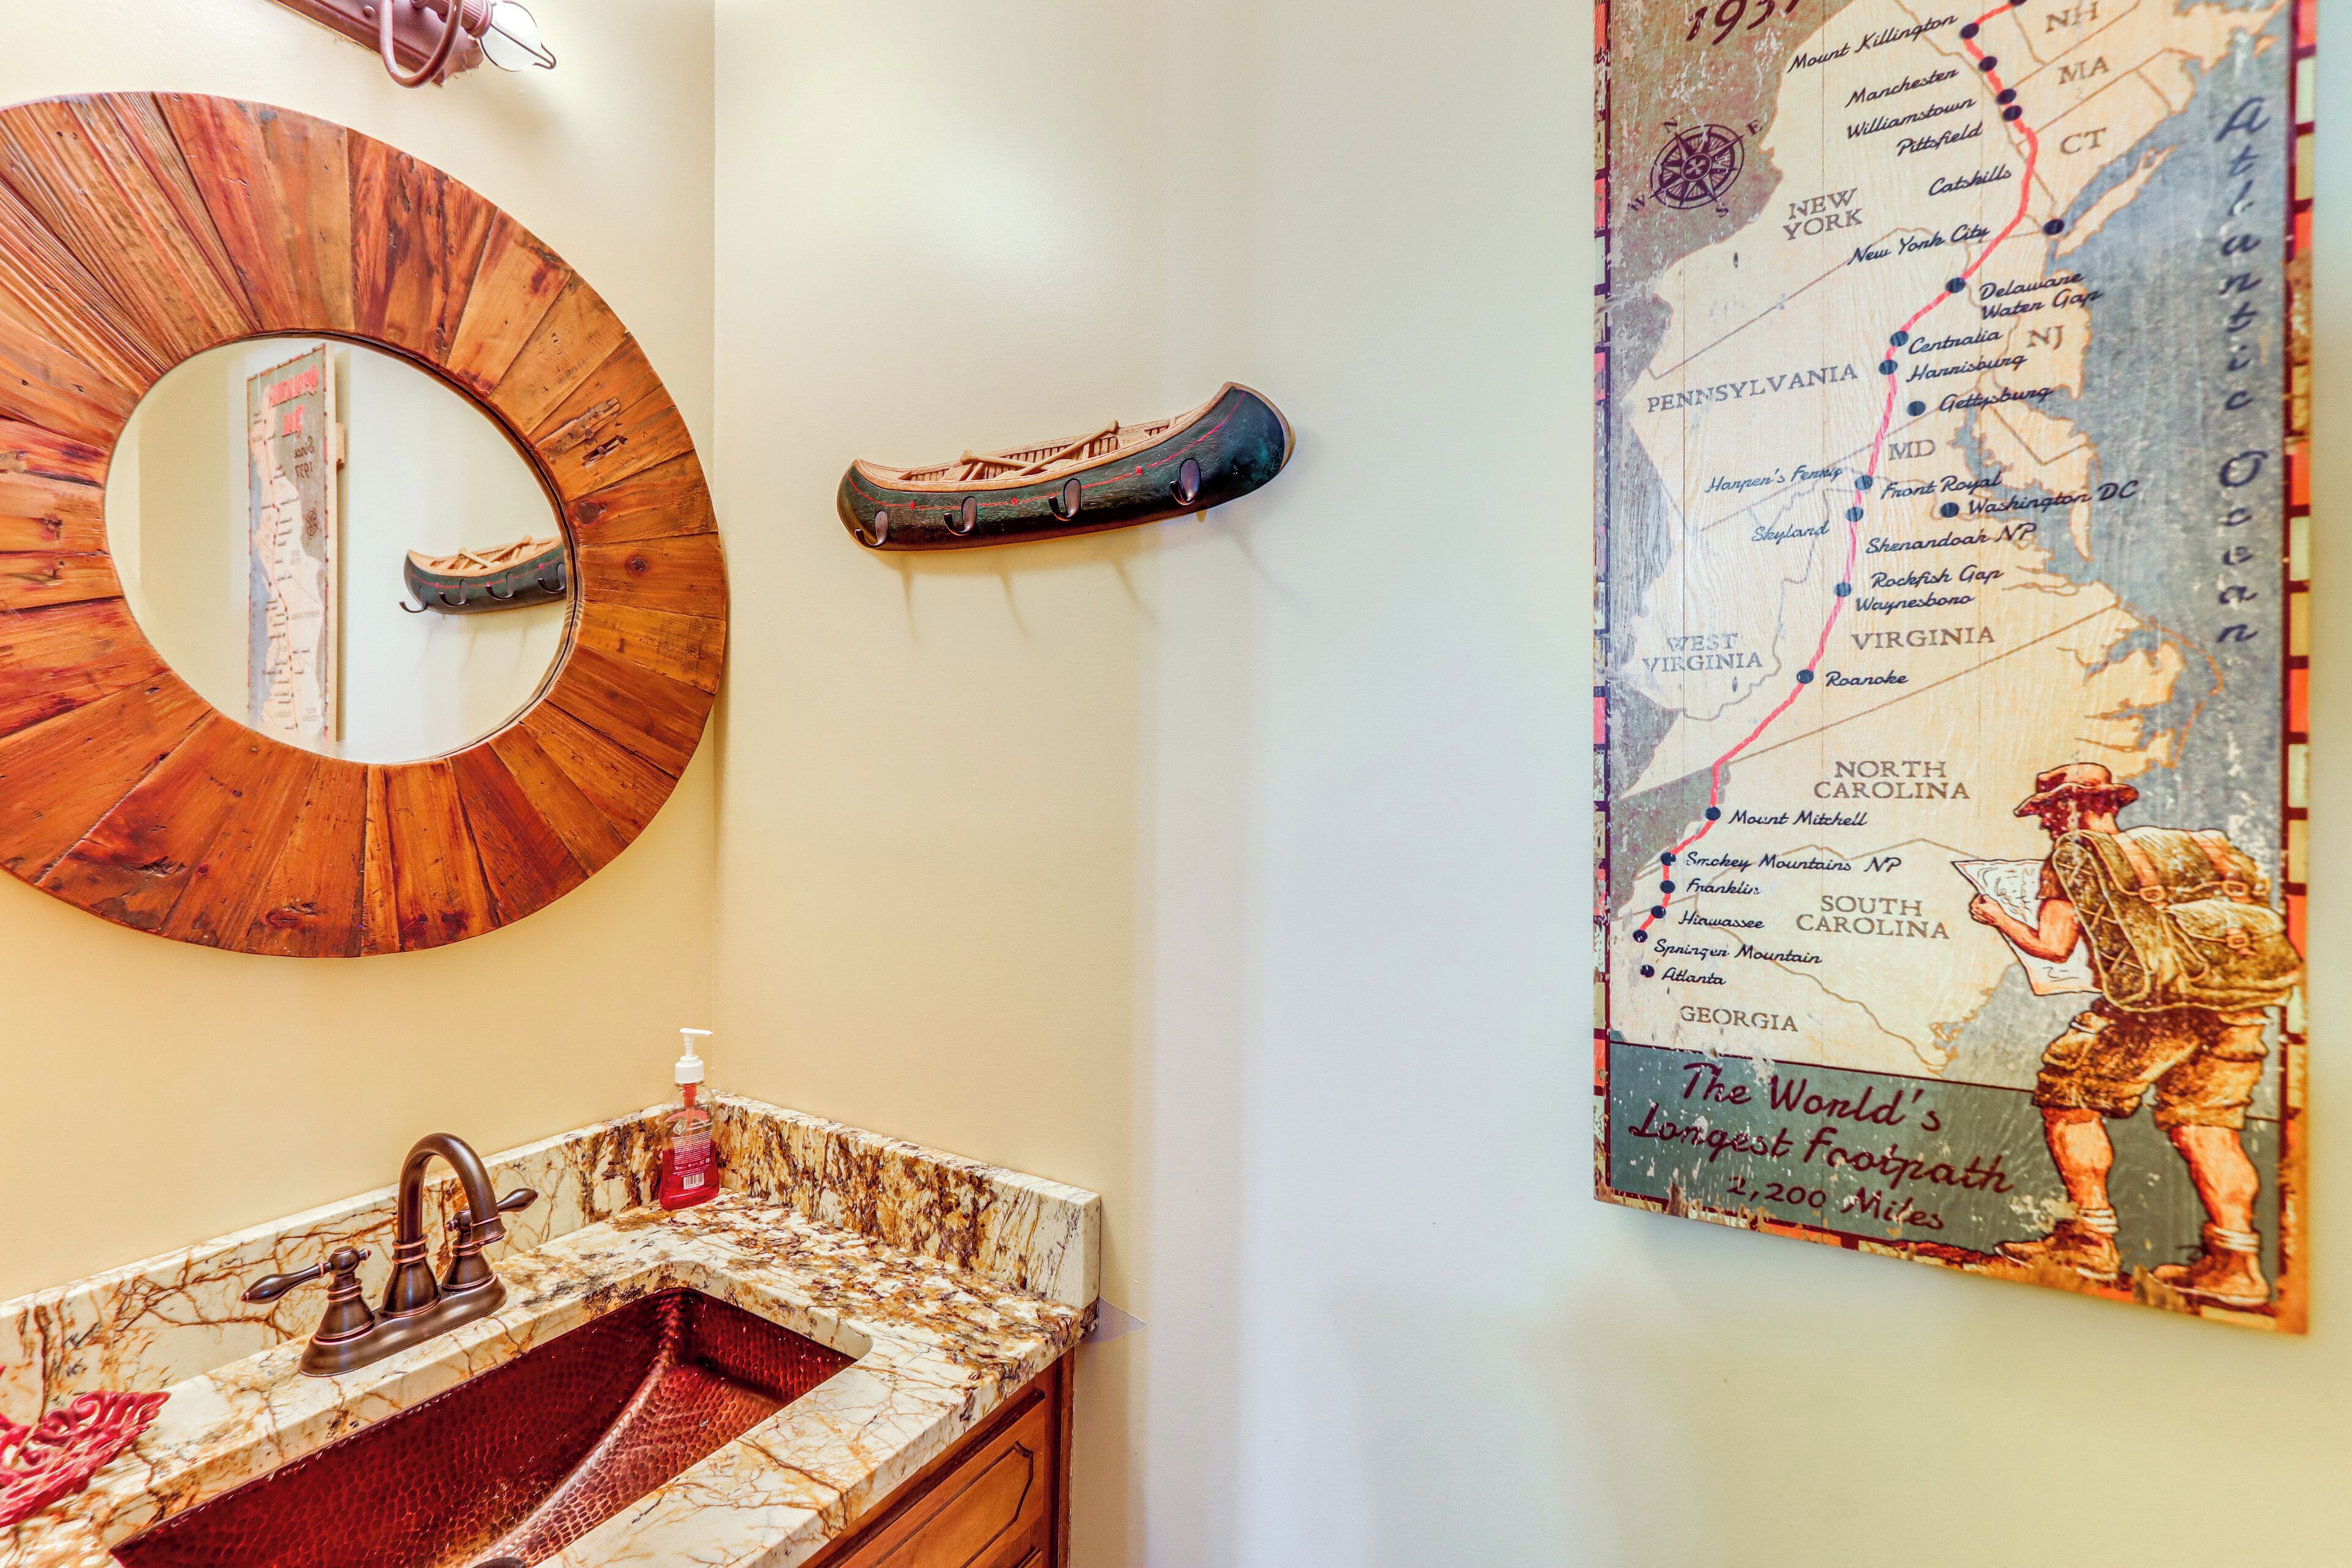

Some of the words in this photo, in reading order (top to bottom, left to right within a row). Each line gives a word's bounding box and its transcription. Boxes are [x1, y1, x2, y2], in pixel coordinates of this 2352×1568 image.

[1686, 0, 1798, 46] 193
[2045, 2, 2100, 33] NH
[1787, 43, 1851, 74] Mount
[1854, 15, 1959, 54] Killington
[2058, 56, 2109, 85] MA
[1845, 69, 1959, 108] Manchester
[1847, 98, 1977, 139] Williamstown
[1896, 121, 1983, 156] Pittsfield
[2060, 128, 2107, 155] CT
[1928, 164, 2012, 196] Catskills
[1789, 188, 1858, 221] NEW
[1783, 208, 1863, 241] YORK
[1847, 244, 1891, 265] New
[1898, 231, 1945, 255] York
[1950, 224, 1991, 243] City
[2215, 96, 2271, 411] Atlantic
[1979, 273, 2086, 300] Delaware
[1981, 302, 2043, 320] Water
[2052, 288, 2105, 308] Gap
[1908, 330, 2003, 355] Centralia
[2027, 326, 2064, 350] NJ
[1905, 355, 2028, 383] Harrisburg
[1647, 363, 1858, 413] PENNSYLVANIA
[1939, 386, 2055, 412] Gettysburg
[1888, 439, 1936, 461] MD
[1704, 469, 1786, 494] Harper's
[1790, 465, 1844, 484] Ferry
[1880, 478, 1936, 499] Front
[1940, 470, 2003, 495] Royal
[1967, 492, 2092, 515] Washington
[2097, 480, 2139, 500] DC
[1752, 521, 1830, 544] Skyland
[1865, 528, 1989, 554] Shenandoah
[1994, 522, 2037, 542] NP
[2218, 450, 2267, 644] Ocean
[1871, 570, 1953, 590] Rockfish
[1959, 564, 2005, 586] Gap
[1855, 592, 1975, 614] Waynesboro
[1667, 633, 1738, 651] WEST
[1850, 626, 1996, 650] VIRGINIA
[1642, 652, 1763, 673] VIRGINIA
[1825, 671, 1909, 687] Roanoke
[1834, 760, 1947, 778] NORTH
[1813, 781, 1970, 800] CAROLINA
[1728, 810, 1789, 826] Mount
[1792, 811, 1868, 827] Mitchell
[1686, 851, 1752, 873] Smokey
[1757, 854, 1852, 872] Mountains
[1863, 856, 1902, 873] NP
[1686, 878, 1761, 895] Franklin
[1679, 910, 1765, 929] Hiawassee
[1820, 895, 1923, 917] SOUTH
[1796, 914, 1950, 940] CAROLINA
[1654, 938, 1730, 960] Springer
[1735, 944, 1823, 964] Mountain
[1661, 967, 1727, 986] Atlanta
[1681, 1005, 1800, 1032] GEORGIA
[1683, 1061, 1752, 1104] The
[1770, 1074, 1942, 1133] World's
[1628, 1102, 1793, 1163] Longest
[1803, 1126, 2015, 1194] Footpath
[1725, 1177, 1827, 1209] 2,200
[1841, 1186, 1945, 1231] Miles
